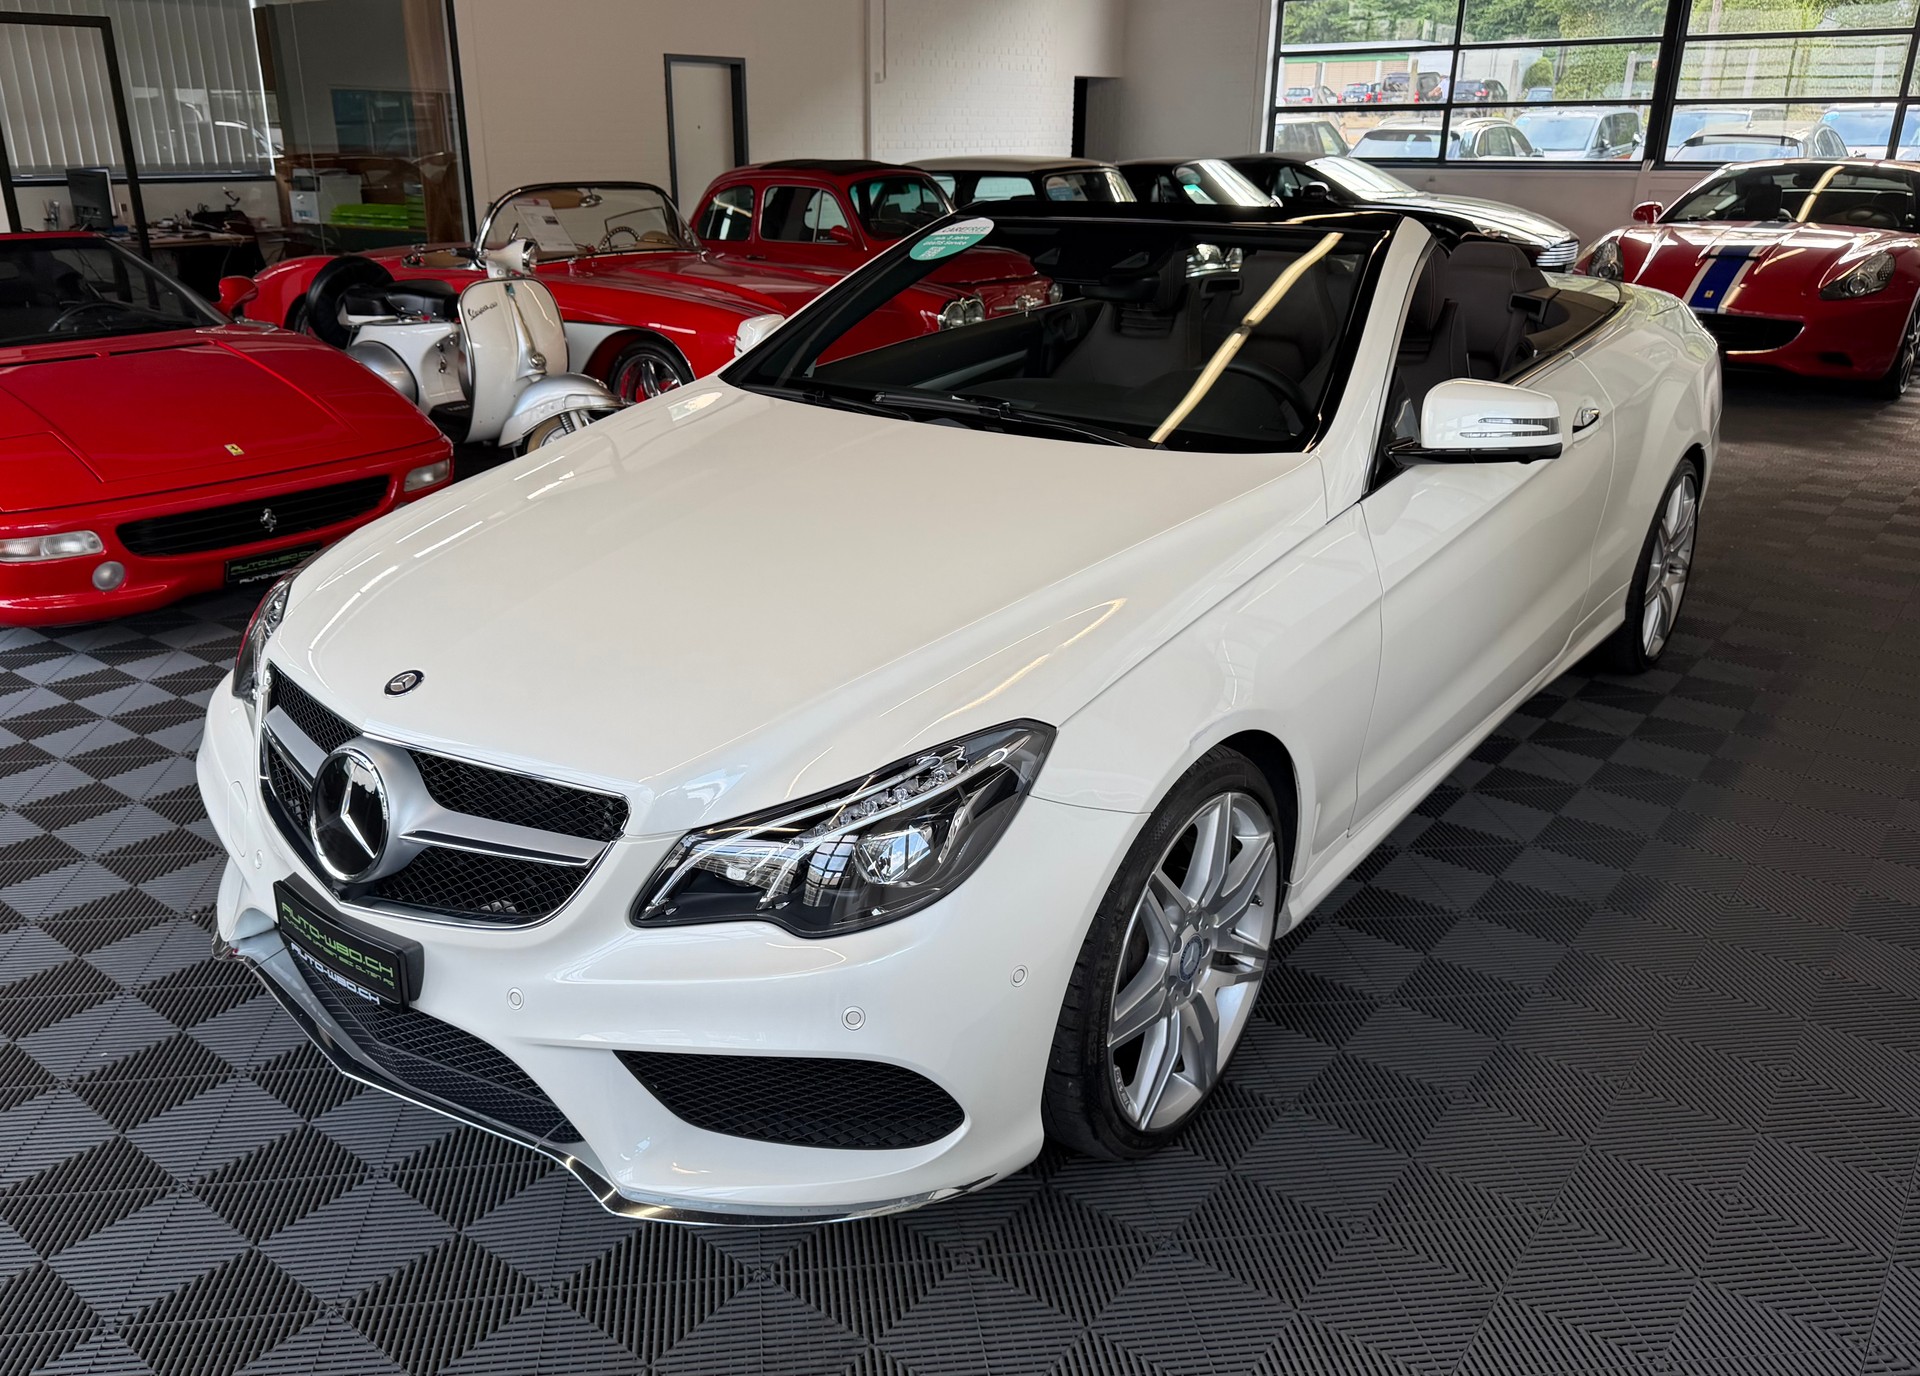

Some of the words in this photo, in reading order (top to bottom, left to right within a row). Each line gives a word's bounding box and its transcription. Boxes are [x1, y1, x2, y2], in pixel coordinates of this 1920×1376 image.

[467, 304, 489, 320] Vespa
[281, 902, 394, 978] AUTO-WBO.CH
[290, 942, 380, 1005] AUTO-WBO.CH
[355, 964, 382, 980] OLTEN
